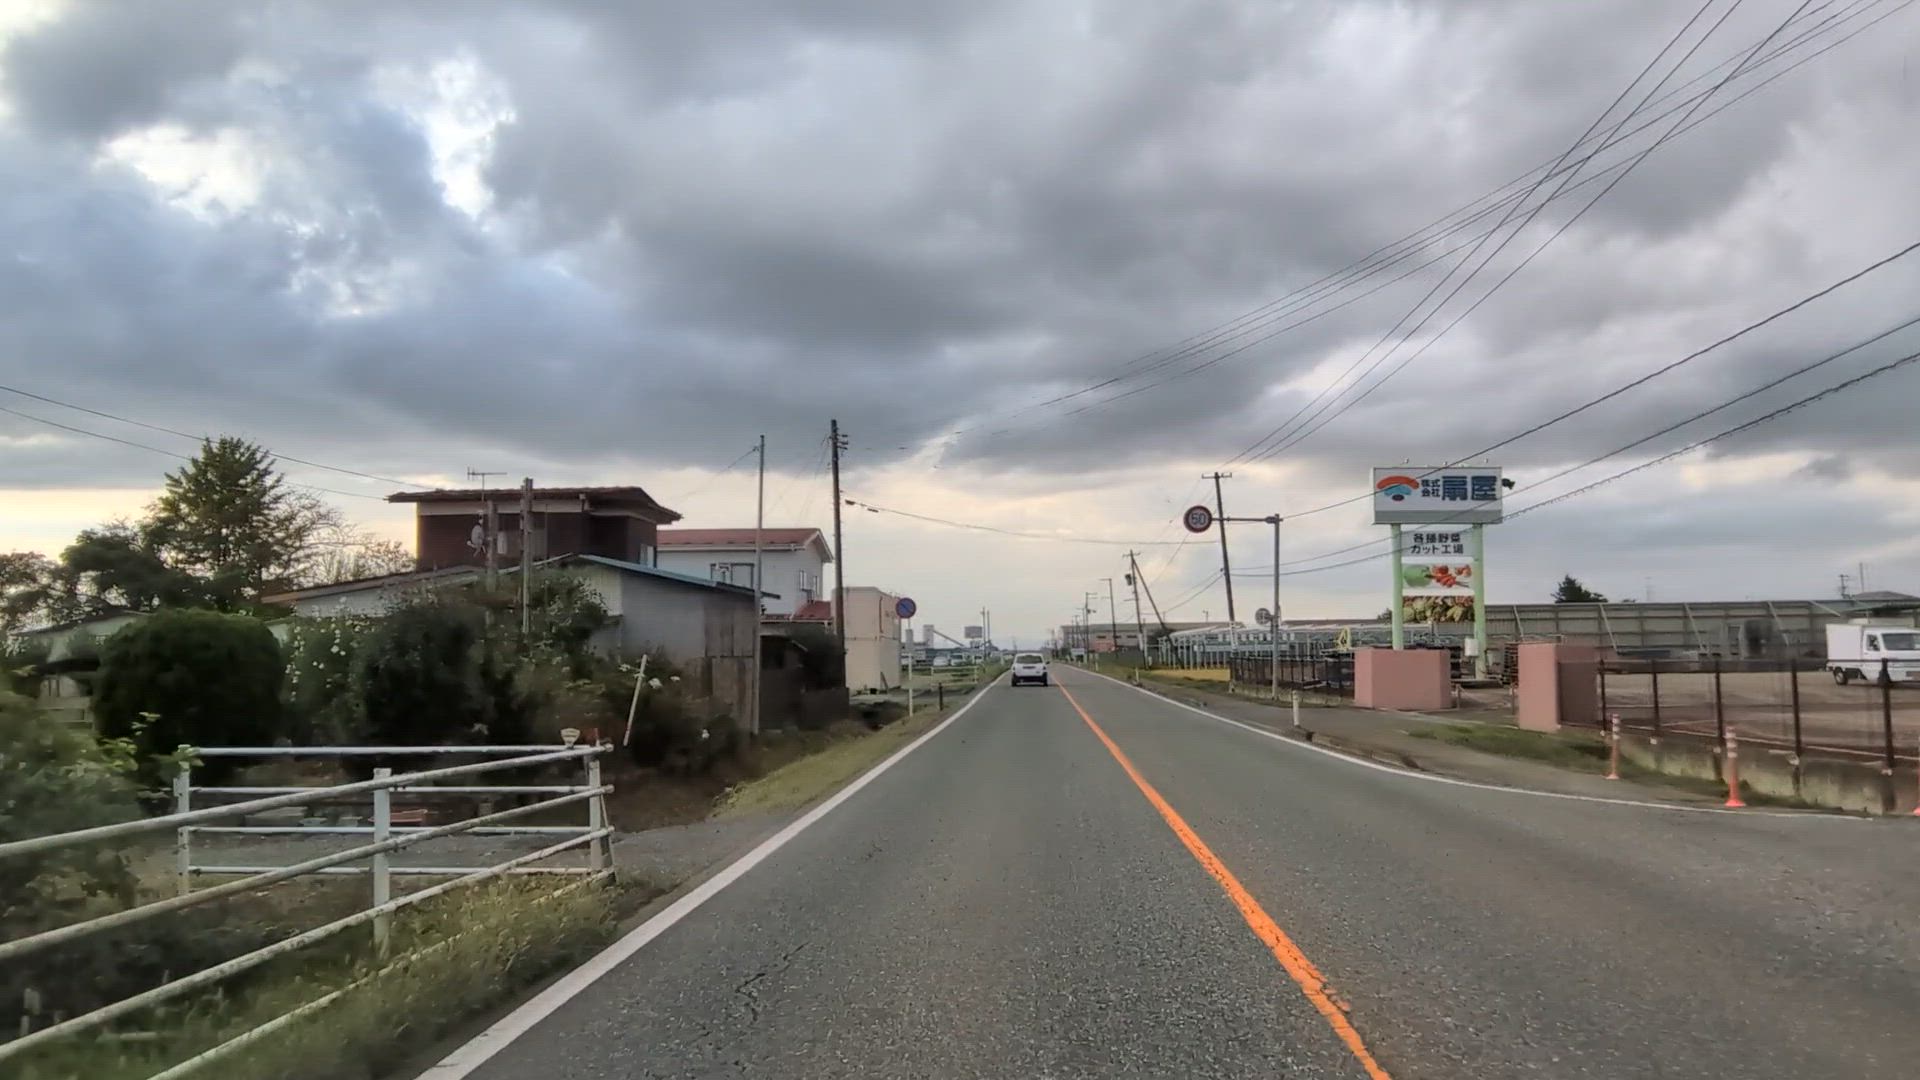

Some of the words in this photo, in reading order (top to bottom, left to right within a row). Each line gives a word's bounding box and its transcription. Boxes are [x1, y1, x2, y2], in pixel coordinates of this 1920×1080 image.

[1421, 488, 1440, 497] 会社
[1191, 512, 1206, 525] 50
[1413, 533, 1460, 543] 各種野菜
[1410, 544, 1464, 554] カット工場
